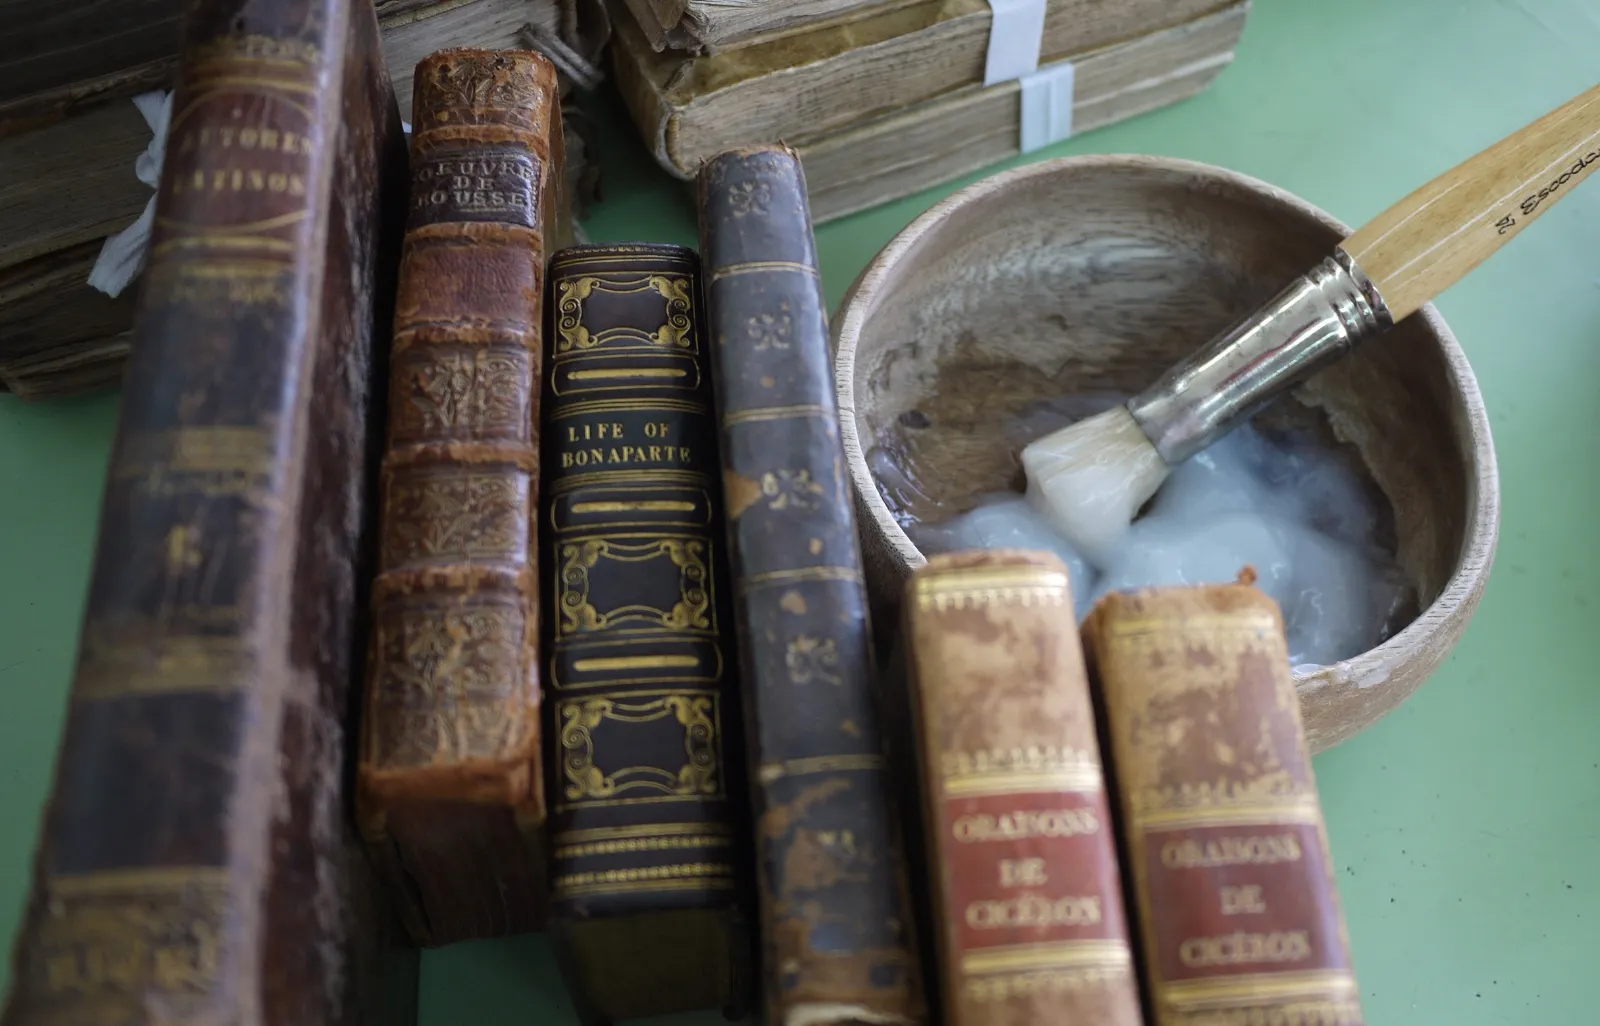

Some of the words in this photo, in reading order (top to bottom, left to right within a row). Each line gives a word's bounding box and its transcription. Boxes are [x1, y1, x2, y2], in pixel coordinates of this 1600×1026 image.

[453, 176, 494, 190] DE
[568, 423, 624, 442] LIFE
[644, 422, 669, 438] OF
[562, 445, 691, 468] BONAPARTE
[999, 857, 1048, 888] DE
[1220, 884, 1267, 915] DE
